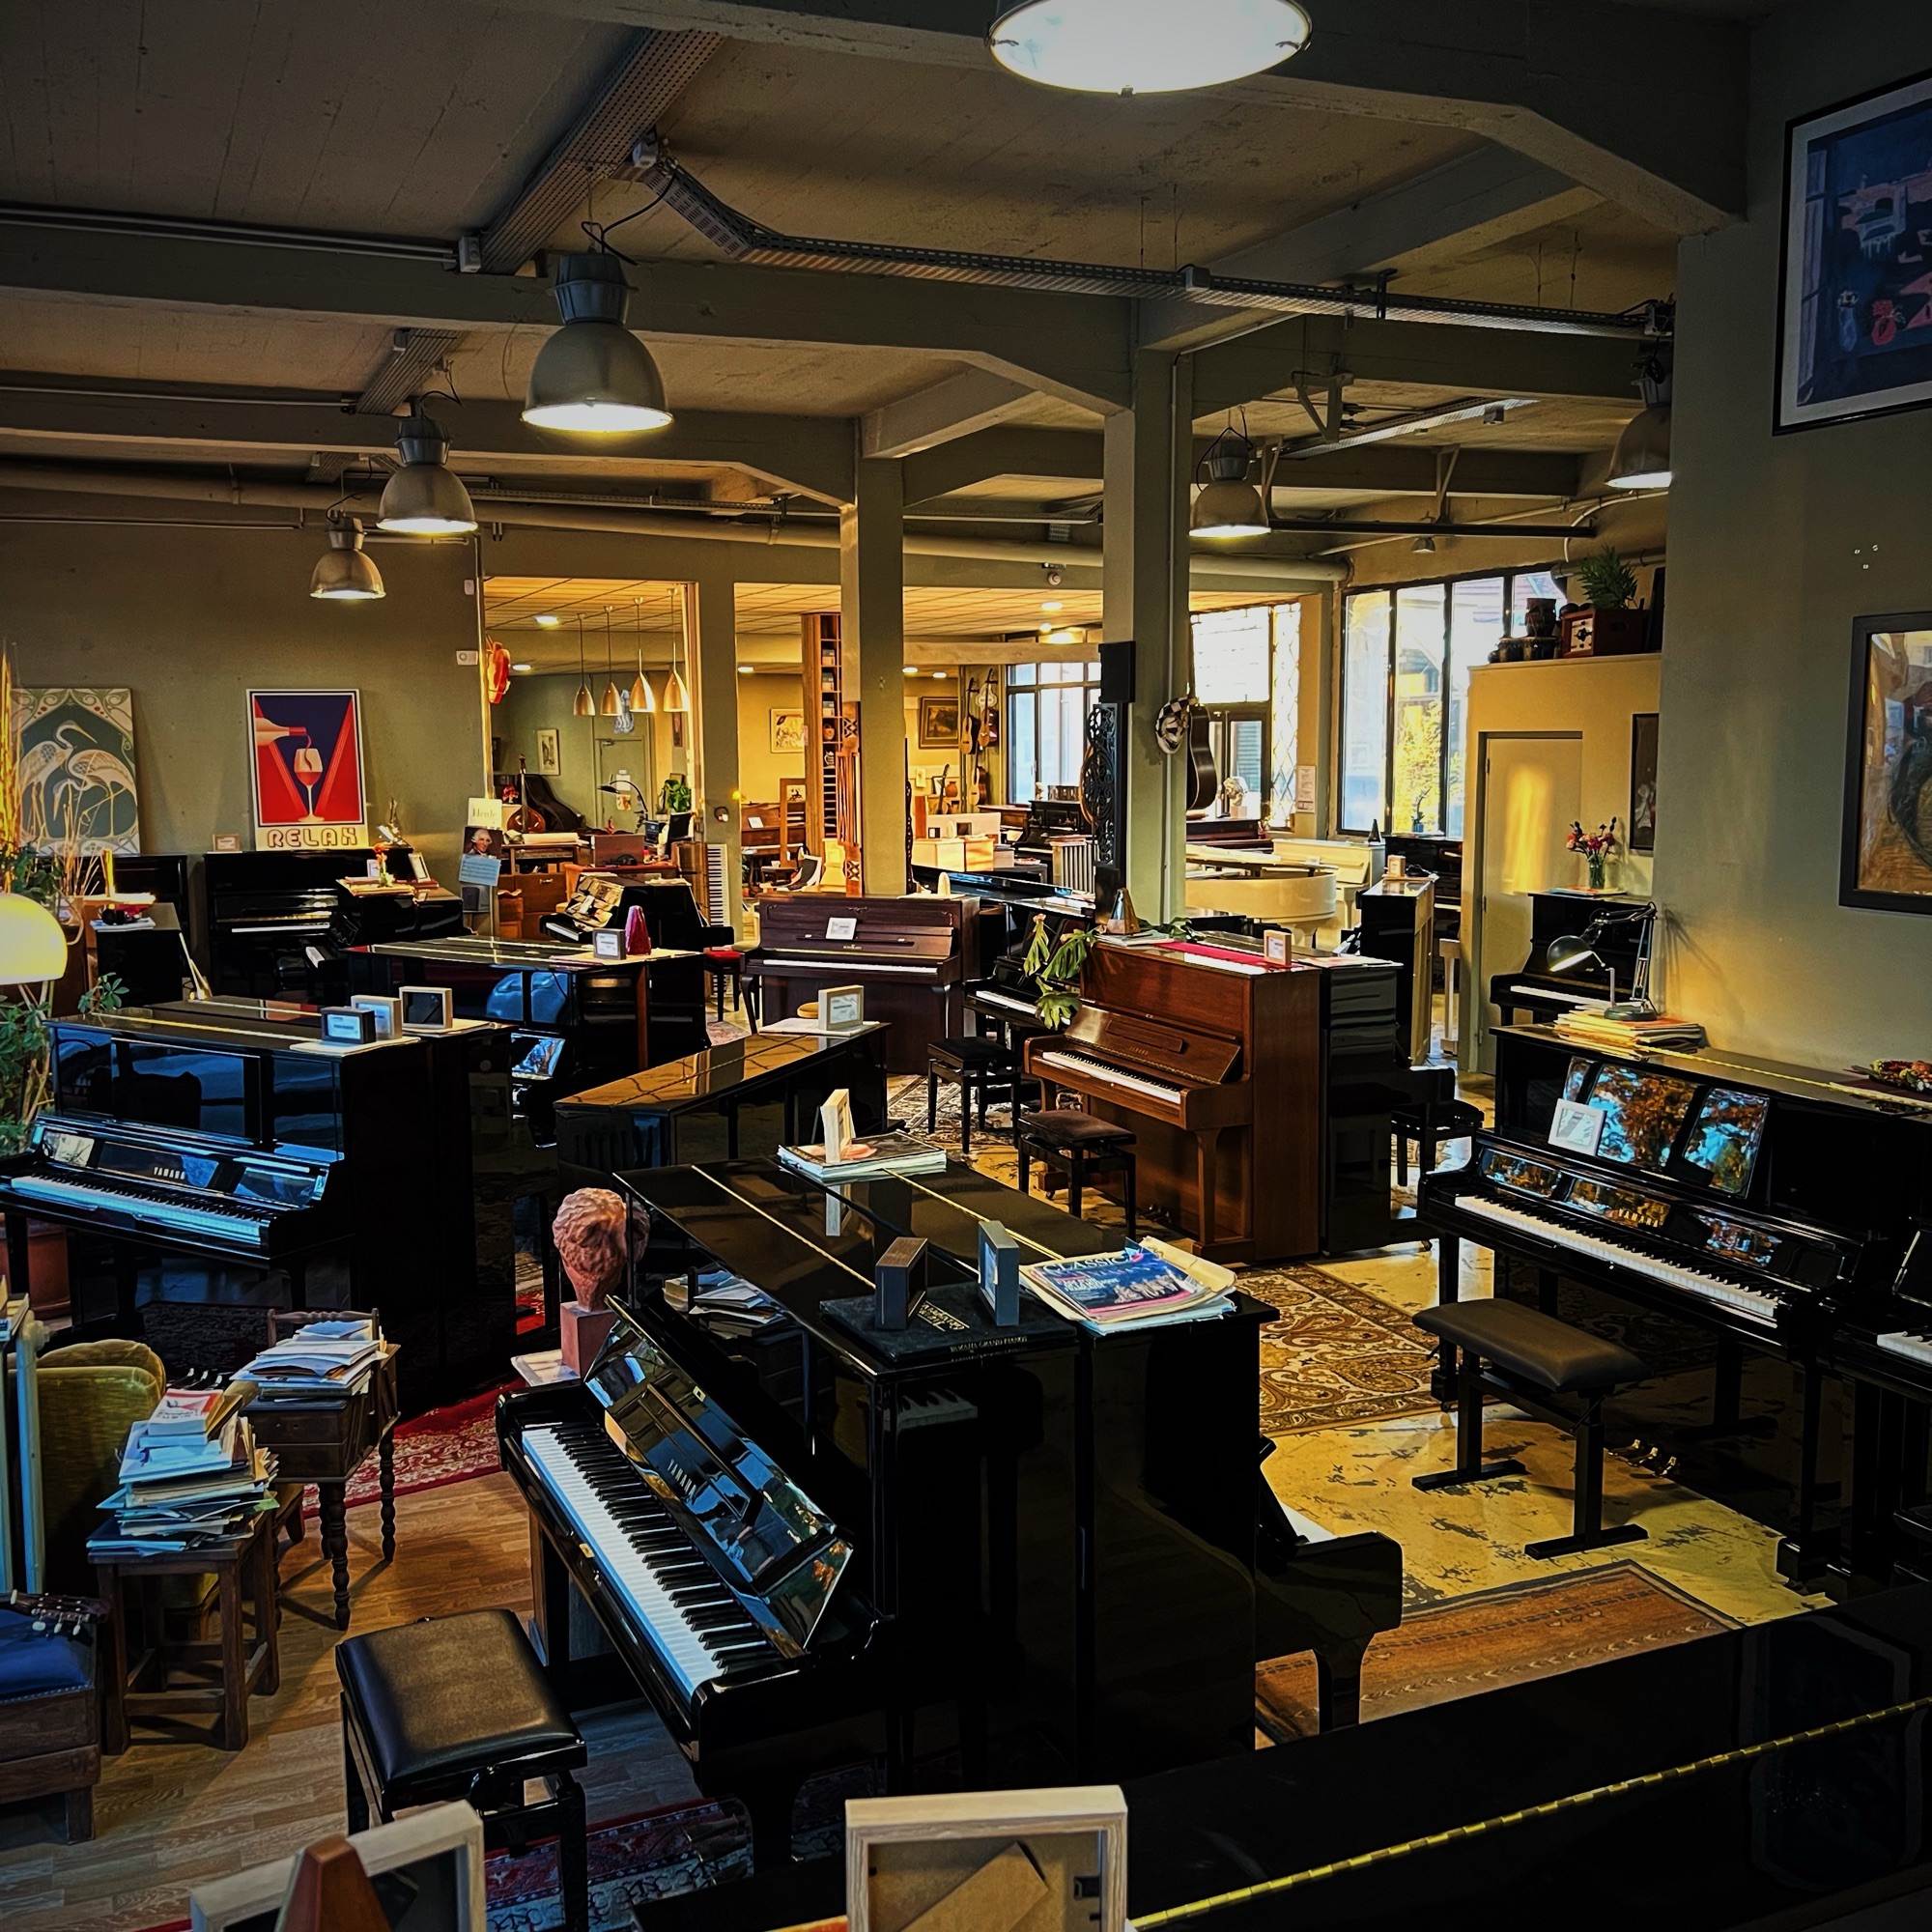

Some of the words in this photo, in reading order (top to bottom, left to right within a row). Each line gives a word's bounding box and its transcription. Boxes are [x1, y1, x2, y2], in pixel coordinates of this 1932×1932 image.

[268, 827, 358, 848] RELAX
[154, 1166, 186, 1179] YAMAHA
[1618, 1208, 1659, 1228] YAMAHA
[979, 1339, 1003, 1349] GRAND
[667, 1459, 696, 1498] YAMAHA
